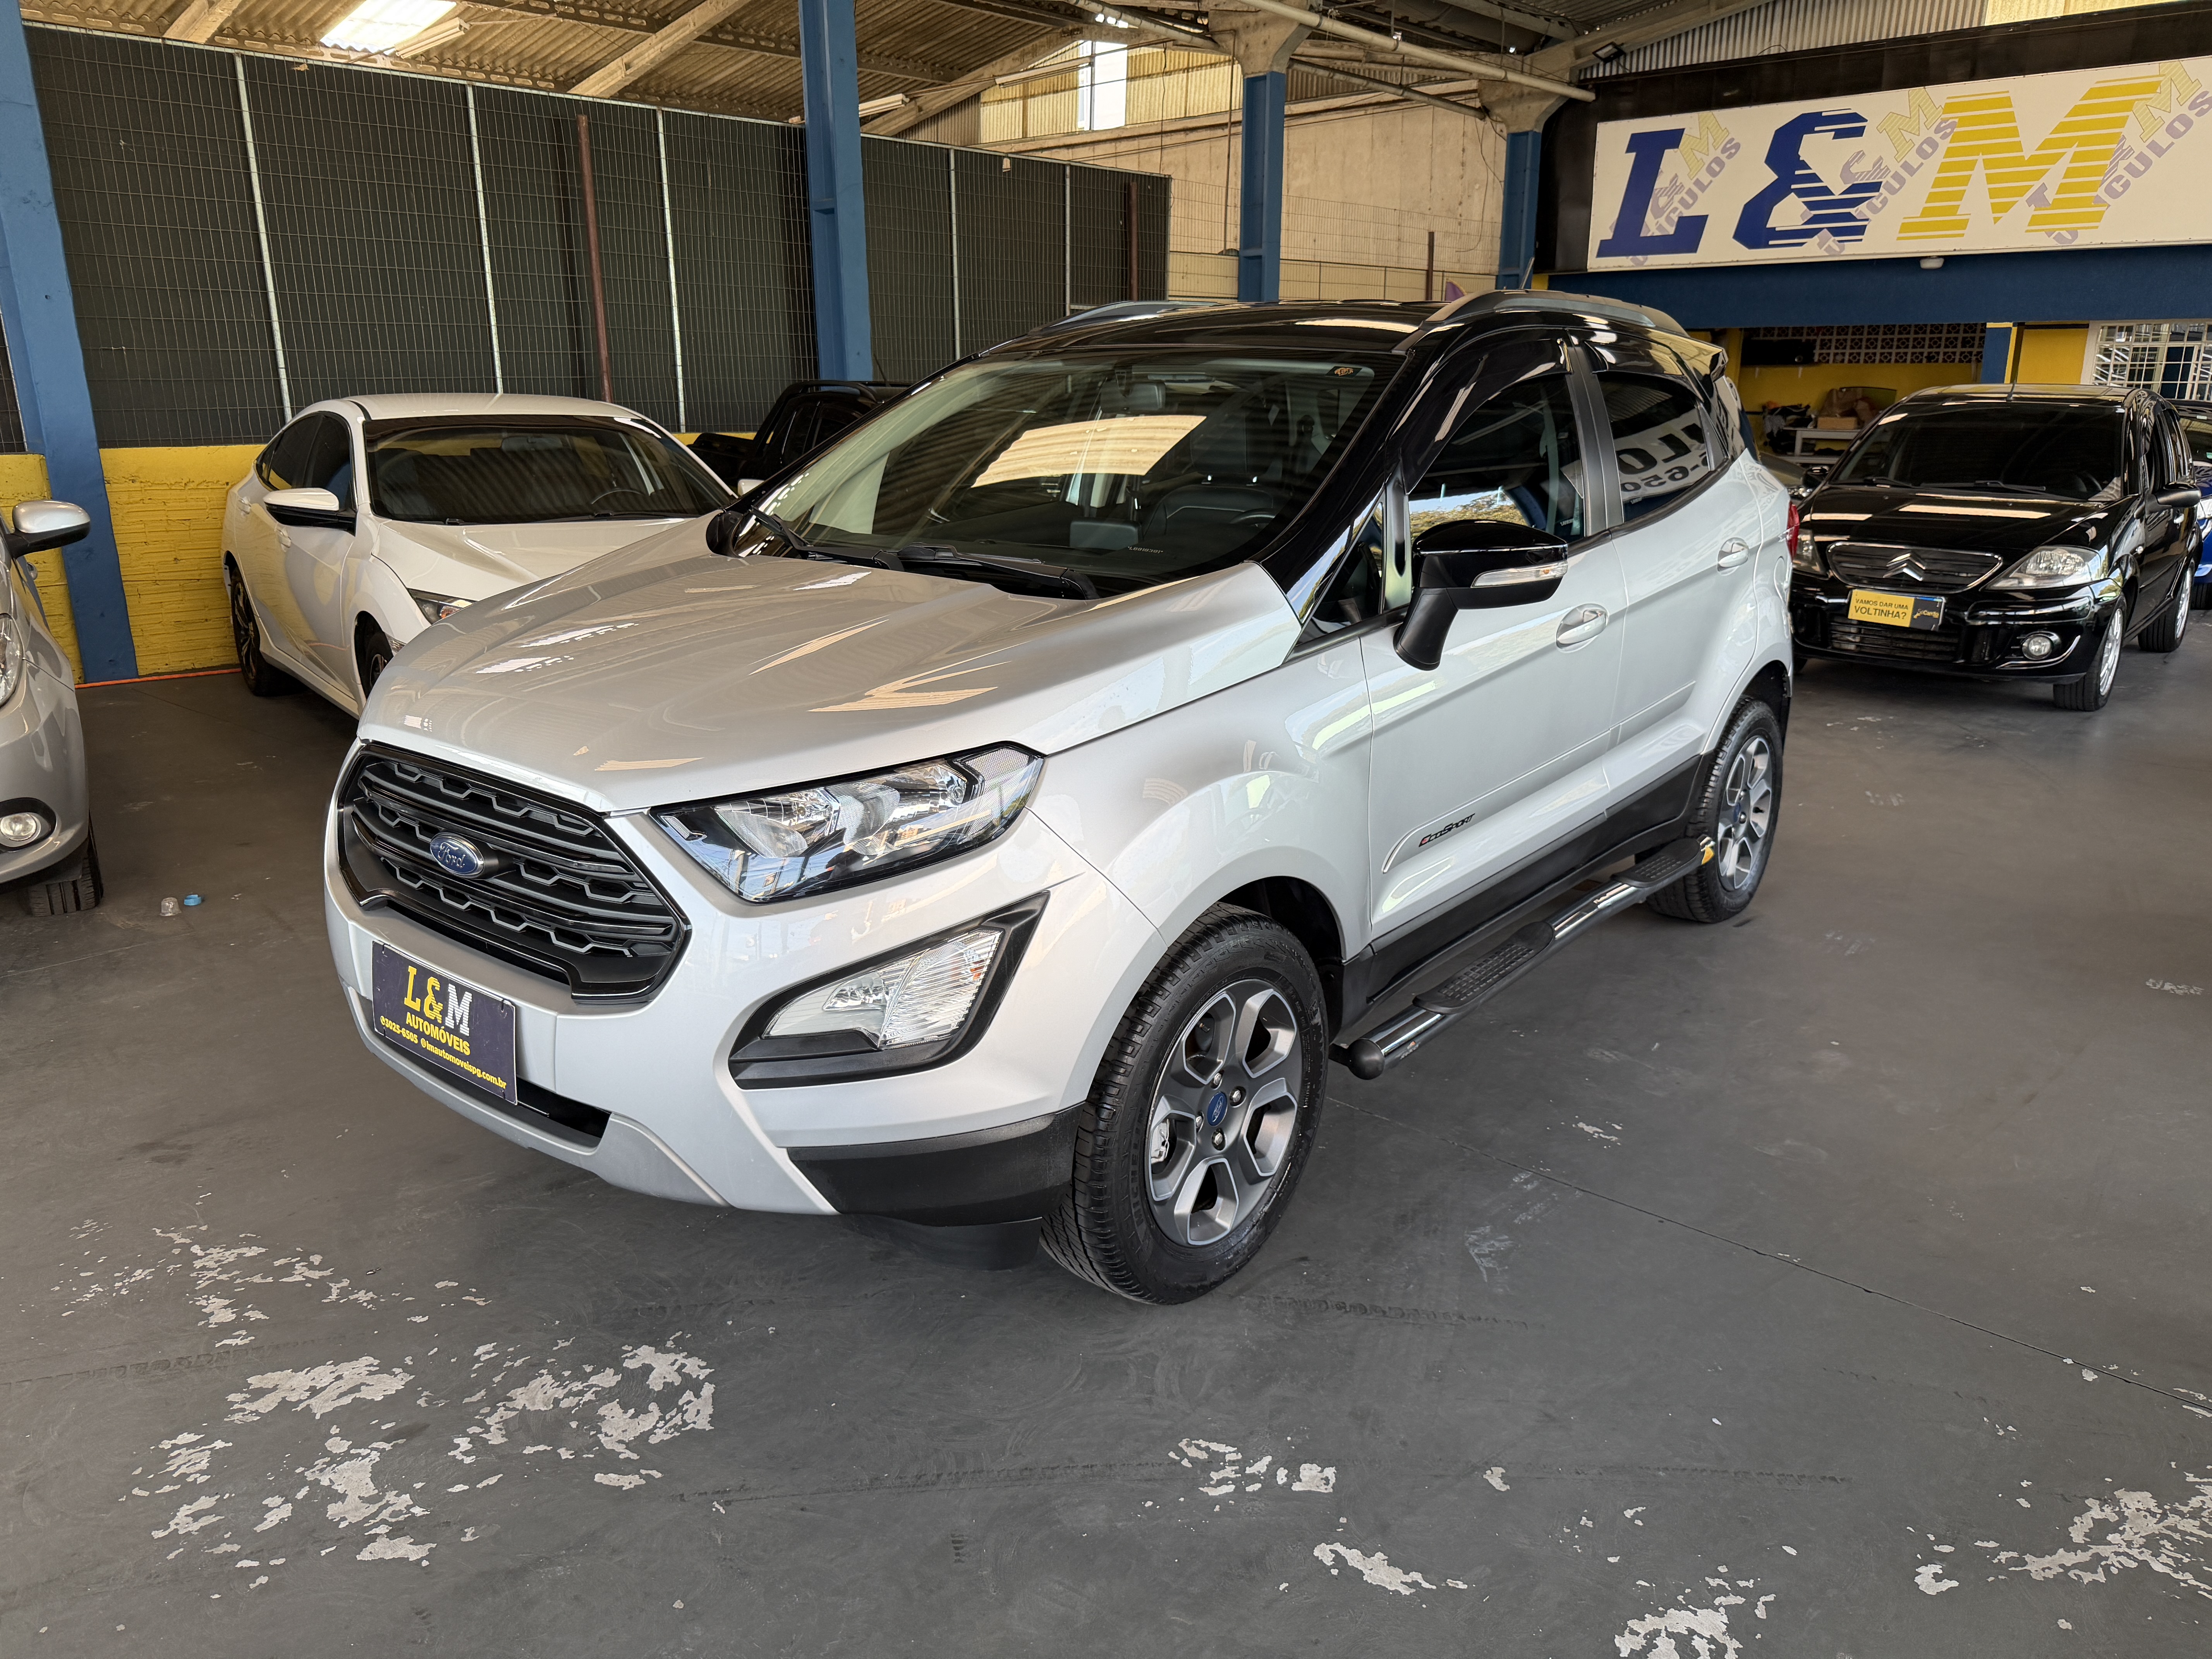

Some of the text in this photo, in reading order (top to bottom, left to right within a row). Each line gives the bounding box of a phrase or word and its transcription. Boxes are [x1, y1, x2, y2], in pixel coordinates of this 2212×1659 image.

[1854, 605, 1907, 620] VOLTINHA?
[1855, 598, 1878, 606] VAMOS
[438, 842, 465, 868] Ford
[404, 965, 472, 1036] L&M
[385, 1018, 419, 1044] 3025-6505
[406, 1012, 471, 1056] AUTOMÓVEIS
[1130, 1106, 1144, 1227] MICHELIN
